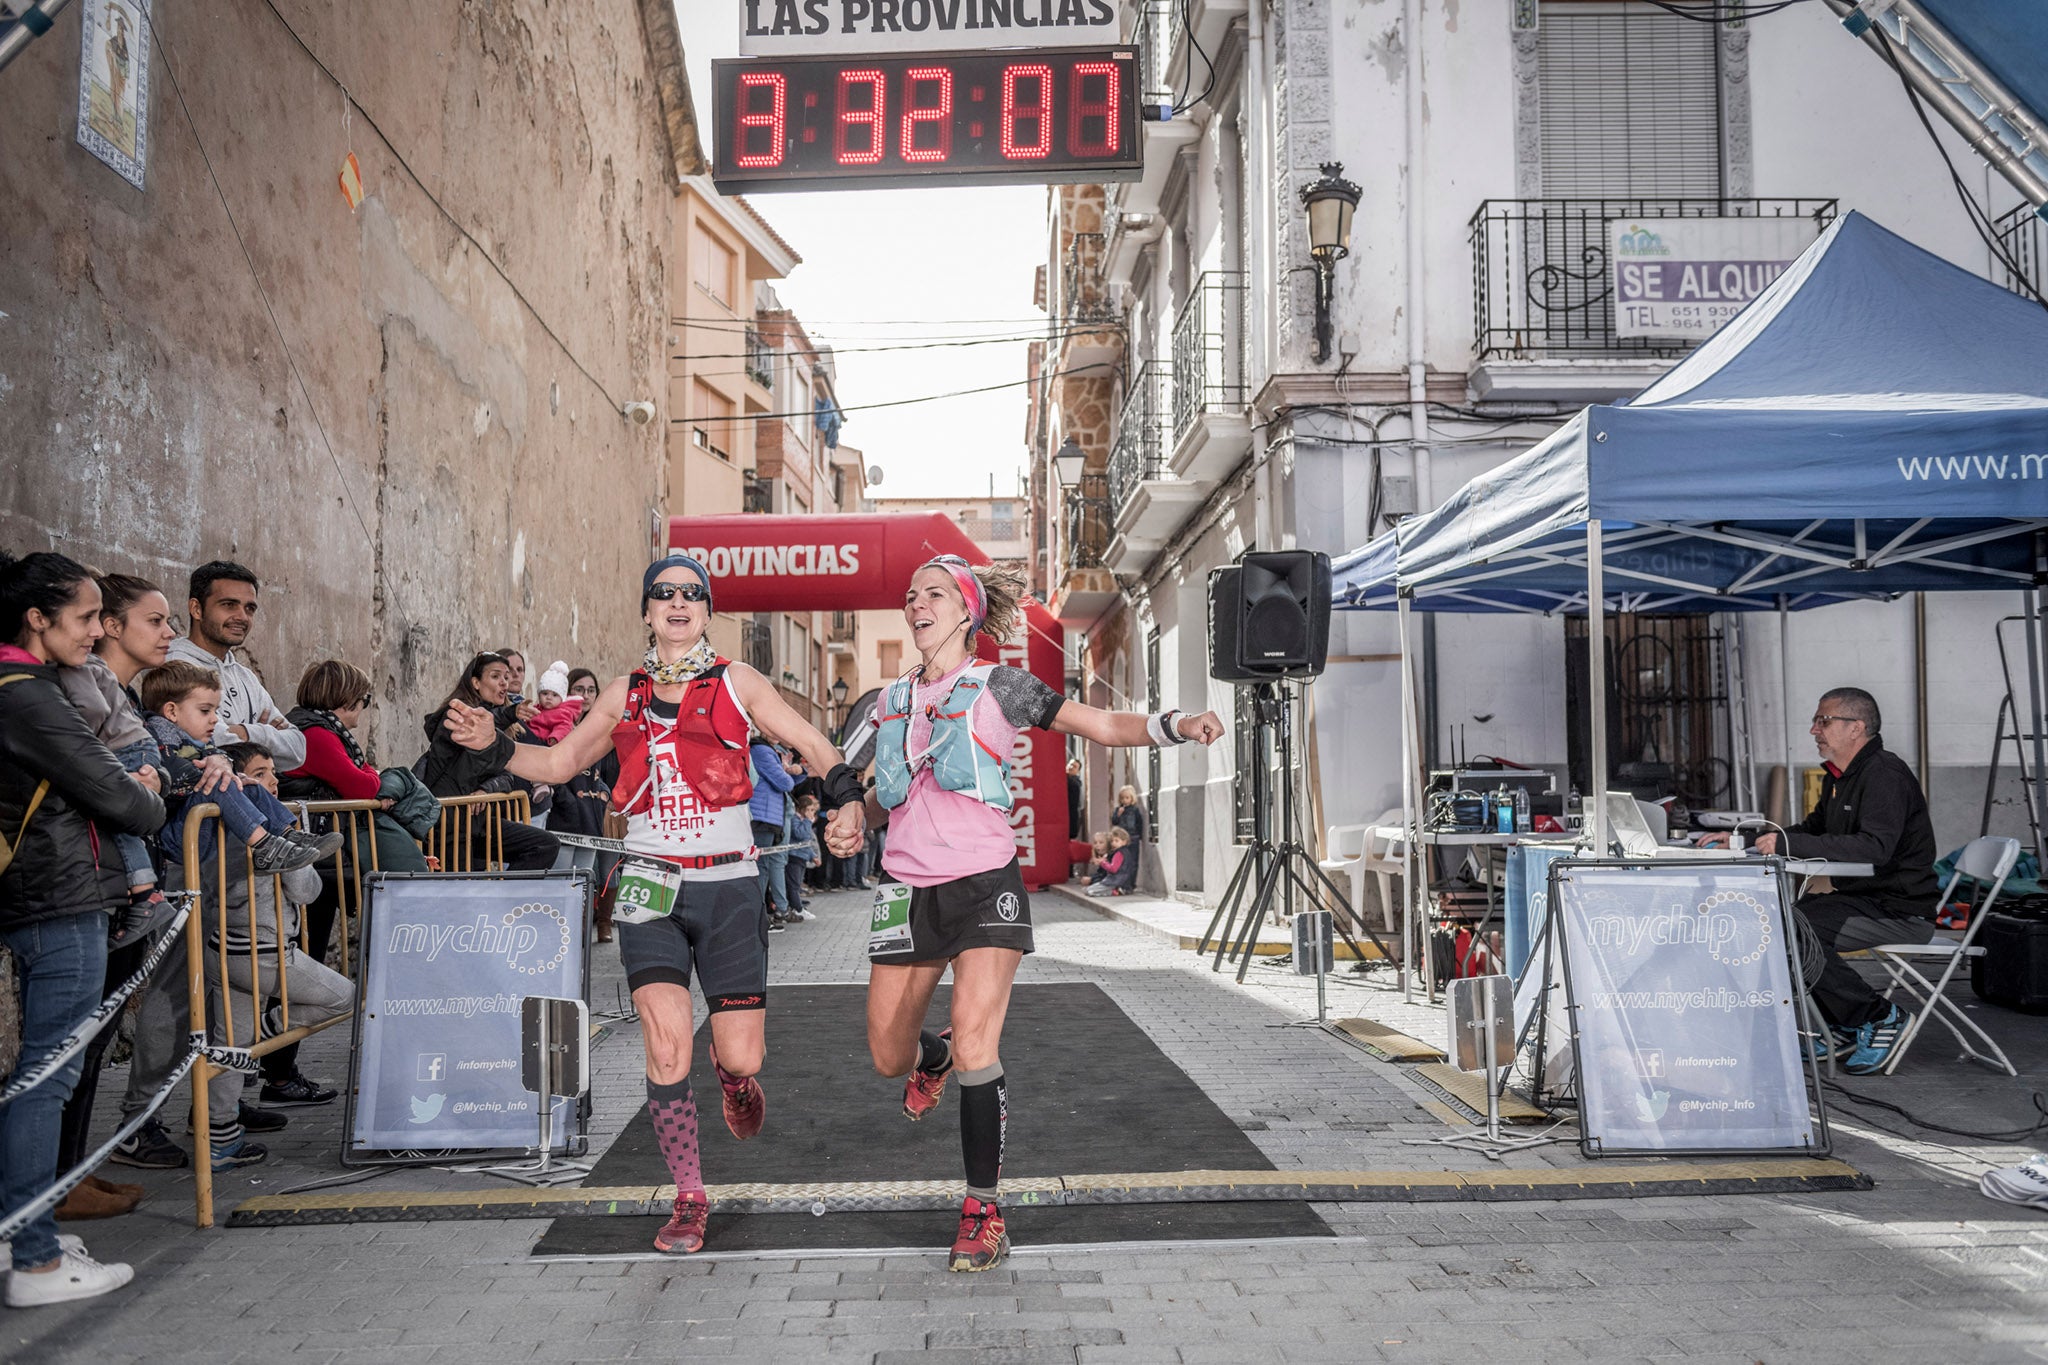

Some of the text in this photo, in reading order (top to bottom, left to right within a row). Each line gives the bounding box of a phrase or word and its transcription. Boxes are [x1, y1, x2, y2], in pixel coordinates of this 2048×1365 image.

[745, 0, 1114, 37] LAS PROVINCIAS
[1623, 265, 1663, 299] SE
[1672, 306, 1700, 316] 651
[1708, 306, 1739, 317] 930
[1672, 319, 1702, 329] 964
[661, 817, 705, 831] TEAM
[619, 884, 651, 905] 637
[1587, 904, 1736, 955] mychip
[388, 914, 538, 963] mychip
[1592, 987, 1775, 1014] www.mychip.es
[456, 1058, 517, 1070] /infomychip
[1675, 1056, 1737, 1067] /infomychip
[452, 1101, 528, 1114] @Mychip_Info
[1679, 1100, 1756, 1112] @Mychip_Info
